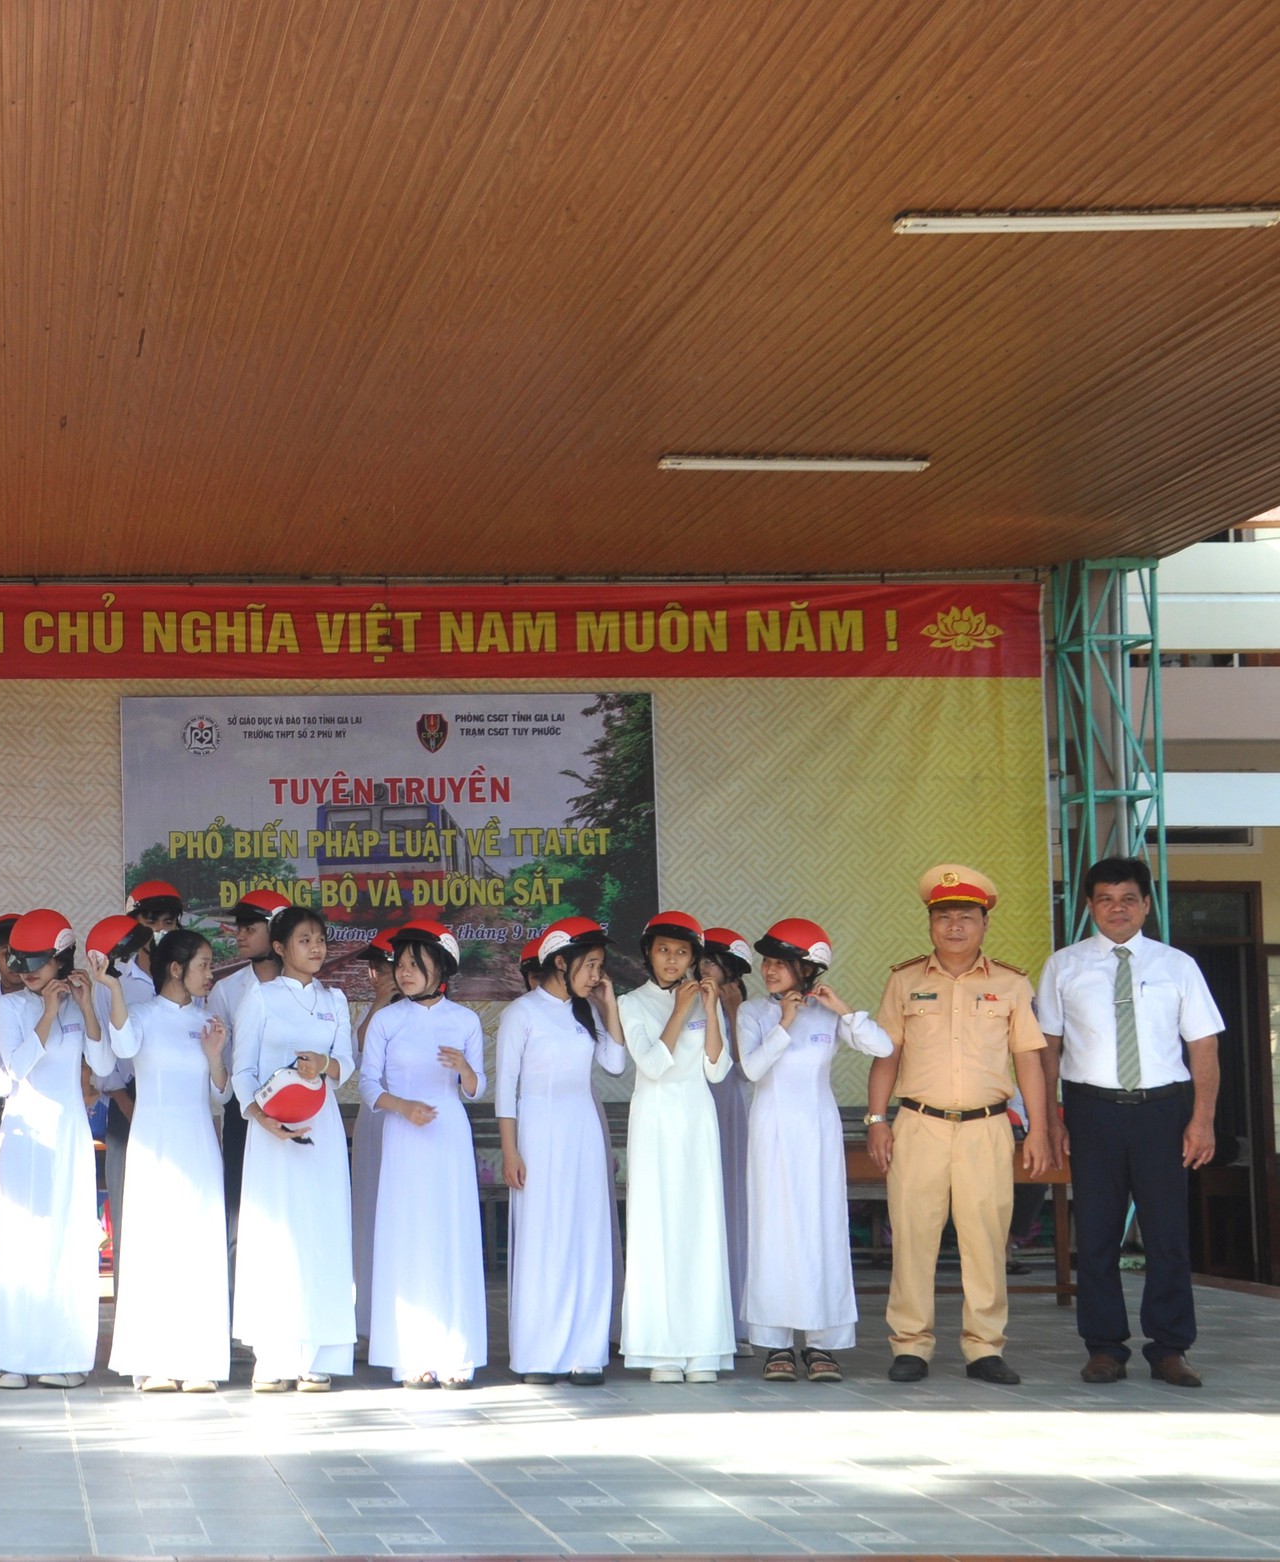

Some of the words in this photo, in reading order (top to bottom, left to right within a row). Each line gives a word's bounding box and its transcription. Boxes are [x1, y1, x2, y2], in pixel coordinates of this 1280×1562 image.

[23, 593, 124, 653] CHỦ
[142, 603, 300, 653] NGHĨA
[316, 603, 422, 662] VIỆT
[439, 611, 558, 653] NAM
[576, 603, 728, 652] MUÔN
[746, 601, 866, 652] NĂM
[883, 609, 900, 652] !
[239, 714, 256, 725] GIÁO
[257, 717, 272, 727] DỤC
[337, 716, 349, 724] GIA
[350, 716, 362, 724] LAI
[454, 712, 485, 722] PHÒNG
[486, 714, 509, 722] CSGT
[511, 711, 531, 722] TỈNH
[534, 714, 549, 722] GIA
[551, 714, 565, 722] LAI
[243, 728, 274, 739] TRƯỜNG
[276, 730, 295, 739] THPT
[297, 727, 308, 739] SỐ
[310, 730, 316, 738] 2
[460, 728, 485, 738] TRẠM
[487, 728, 509, 736] CSGT
[512, 727, 529, 736] TUY
[532, 725, 562, 736] PHƯỚC
[268, 770, 375, 805] TUYÊN
[384, 765, 511, 805] TRUYỀN
[169, 815, 225, 859] PHỔ
[234, 819, 299, 859] BIẾN
[307, 822, 381, 858] PHÁP
[388, 822, 457, 862] LUẬT
[465, 816, 501, 857] VỀ
[510, 827, 611, 857] TTATGT
[321, 872, 358, 913] BỘ
[367, 871, 402, 907] VÀ
[412, 871, 505, 906] ĐƯỜNG
[513, 866, 564, 905] SẮT
[457, 923, 507, 943] tháng
[512, 923, 523, 940] 9
